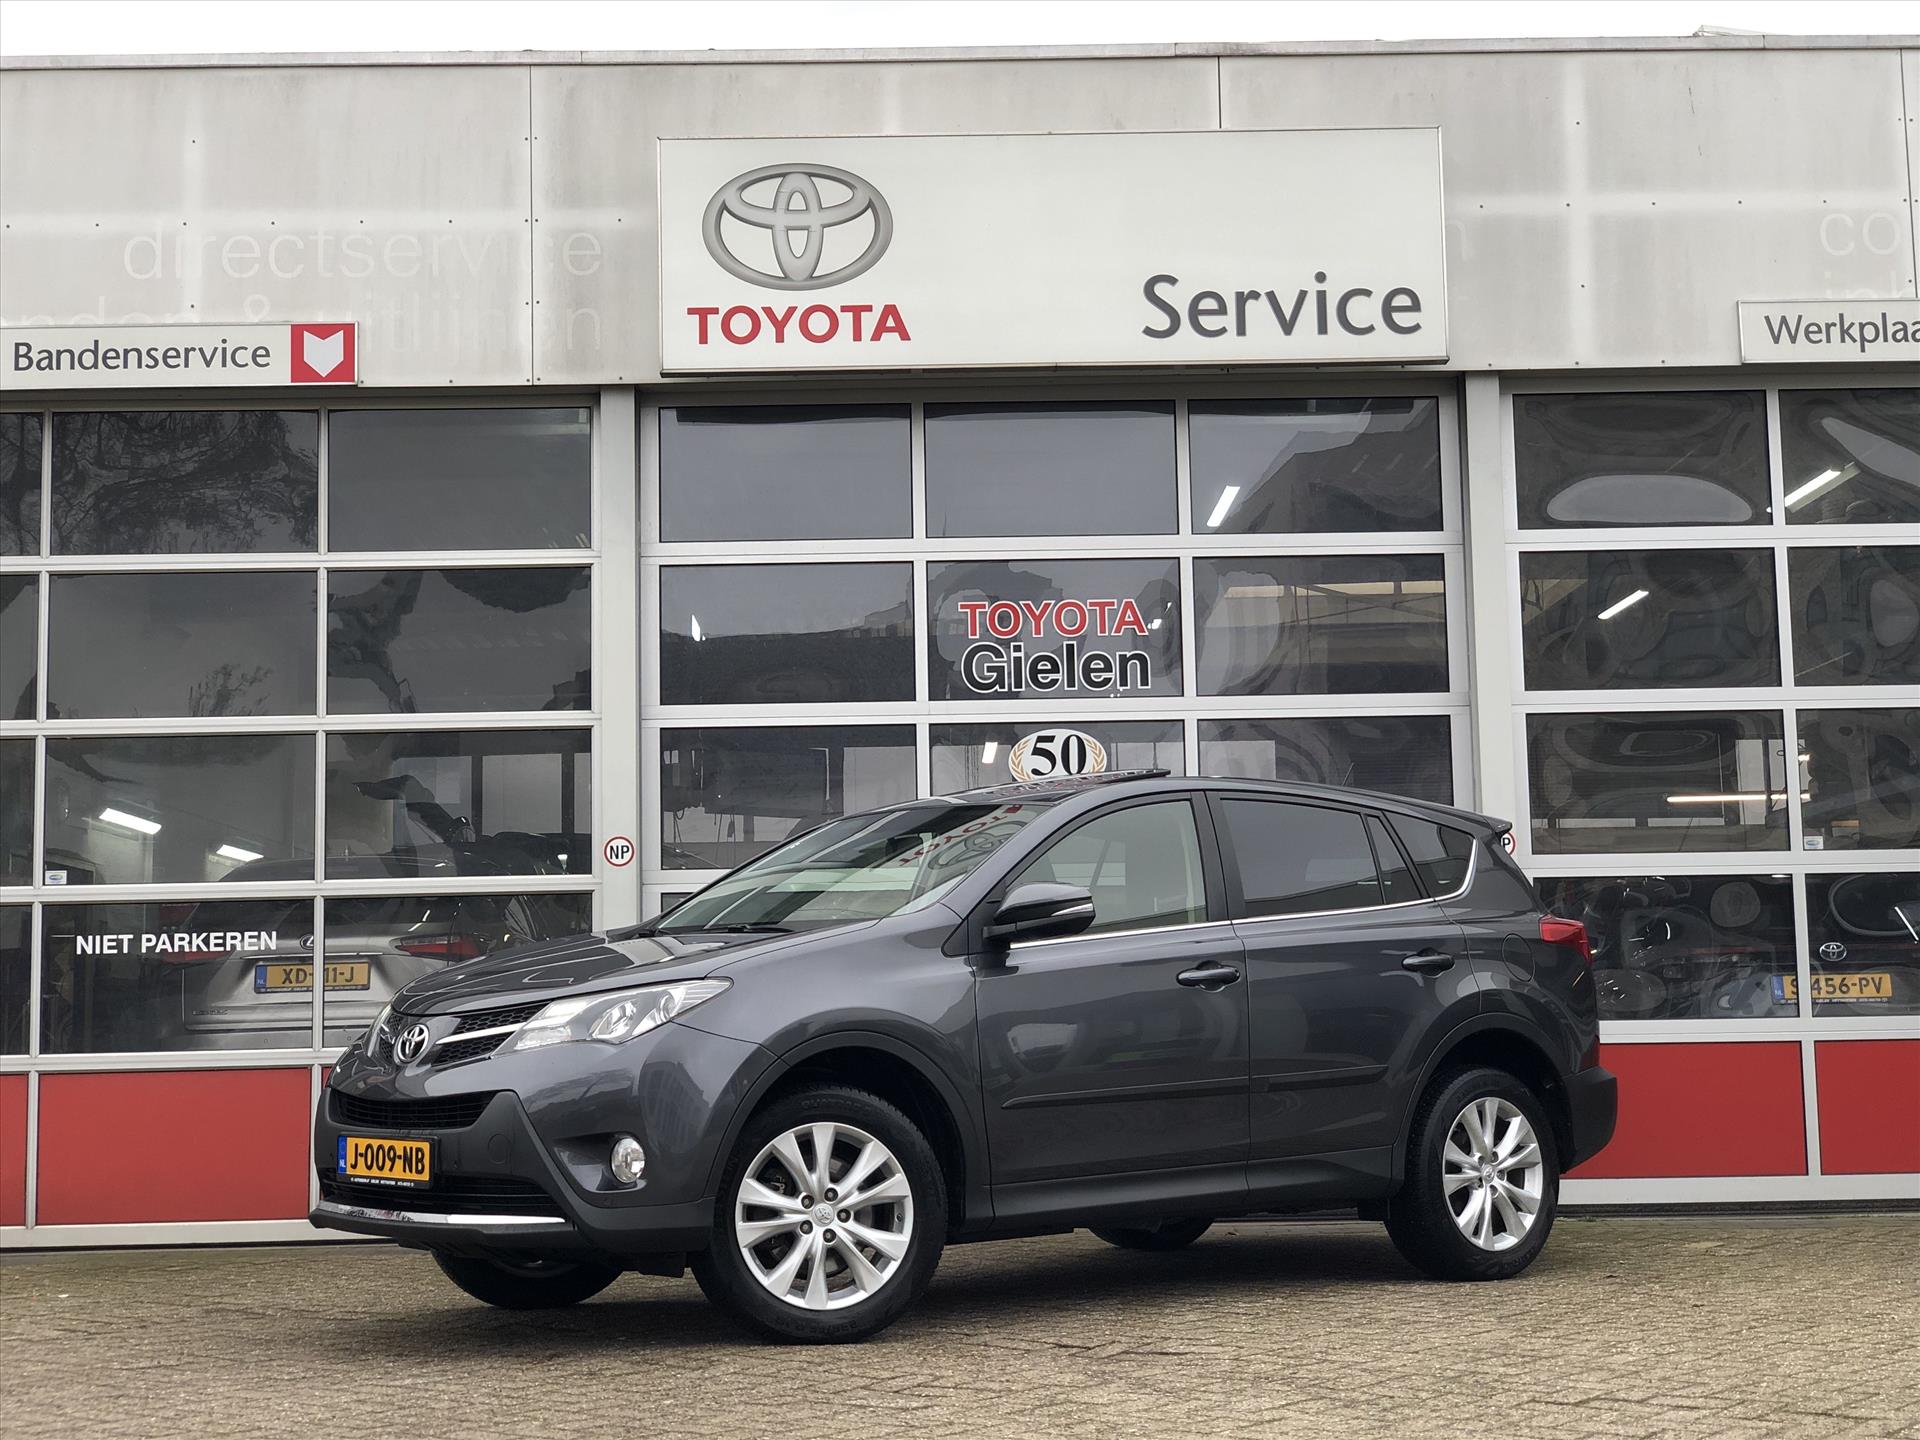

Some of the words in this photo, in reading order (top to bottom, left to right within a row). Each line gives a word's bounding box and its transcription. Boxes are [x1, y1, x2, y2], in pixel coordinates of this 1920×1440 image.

[686, 303, 912, 345] TOYOTA
[1142, 271, 1422, 339] Service
[13, 338, 271, 371] Bandenservice
[958, 599, 1148, 638] TOYOTA
[961, 641, 1151, 693] Gielen
[1030, 734, 1087, 777] 50
[609, 845, 630, 860] NP
[76, 934, 133, 955] NIET
[141, 931, 277, 953] PARKEREN
[350, 1142, 425, 1175] J-009-NB
